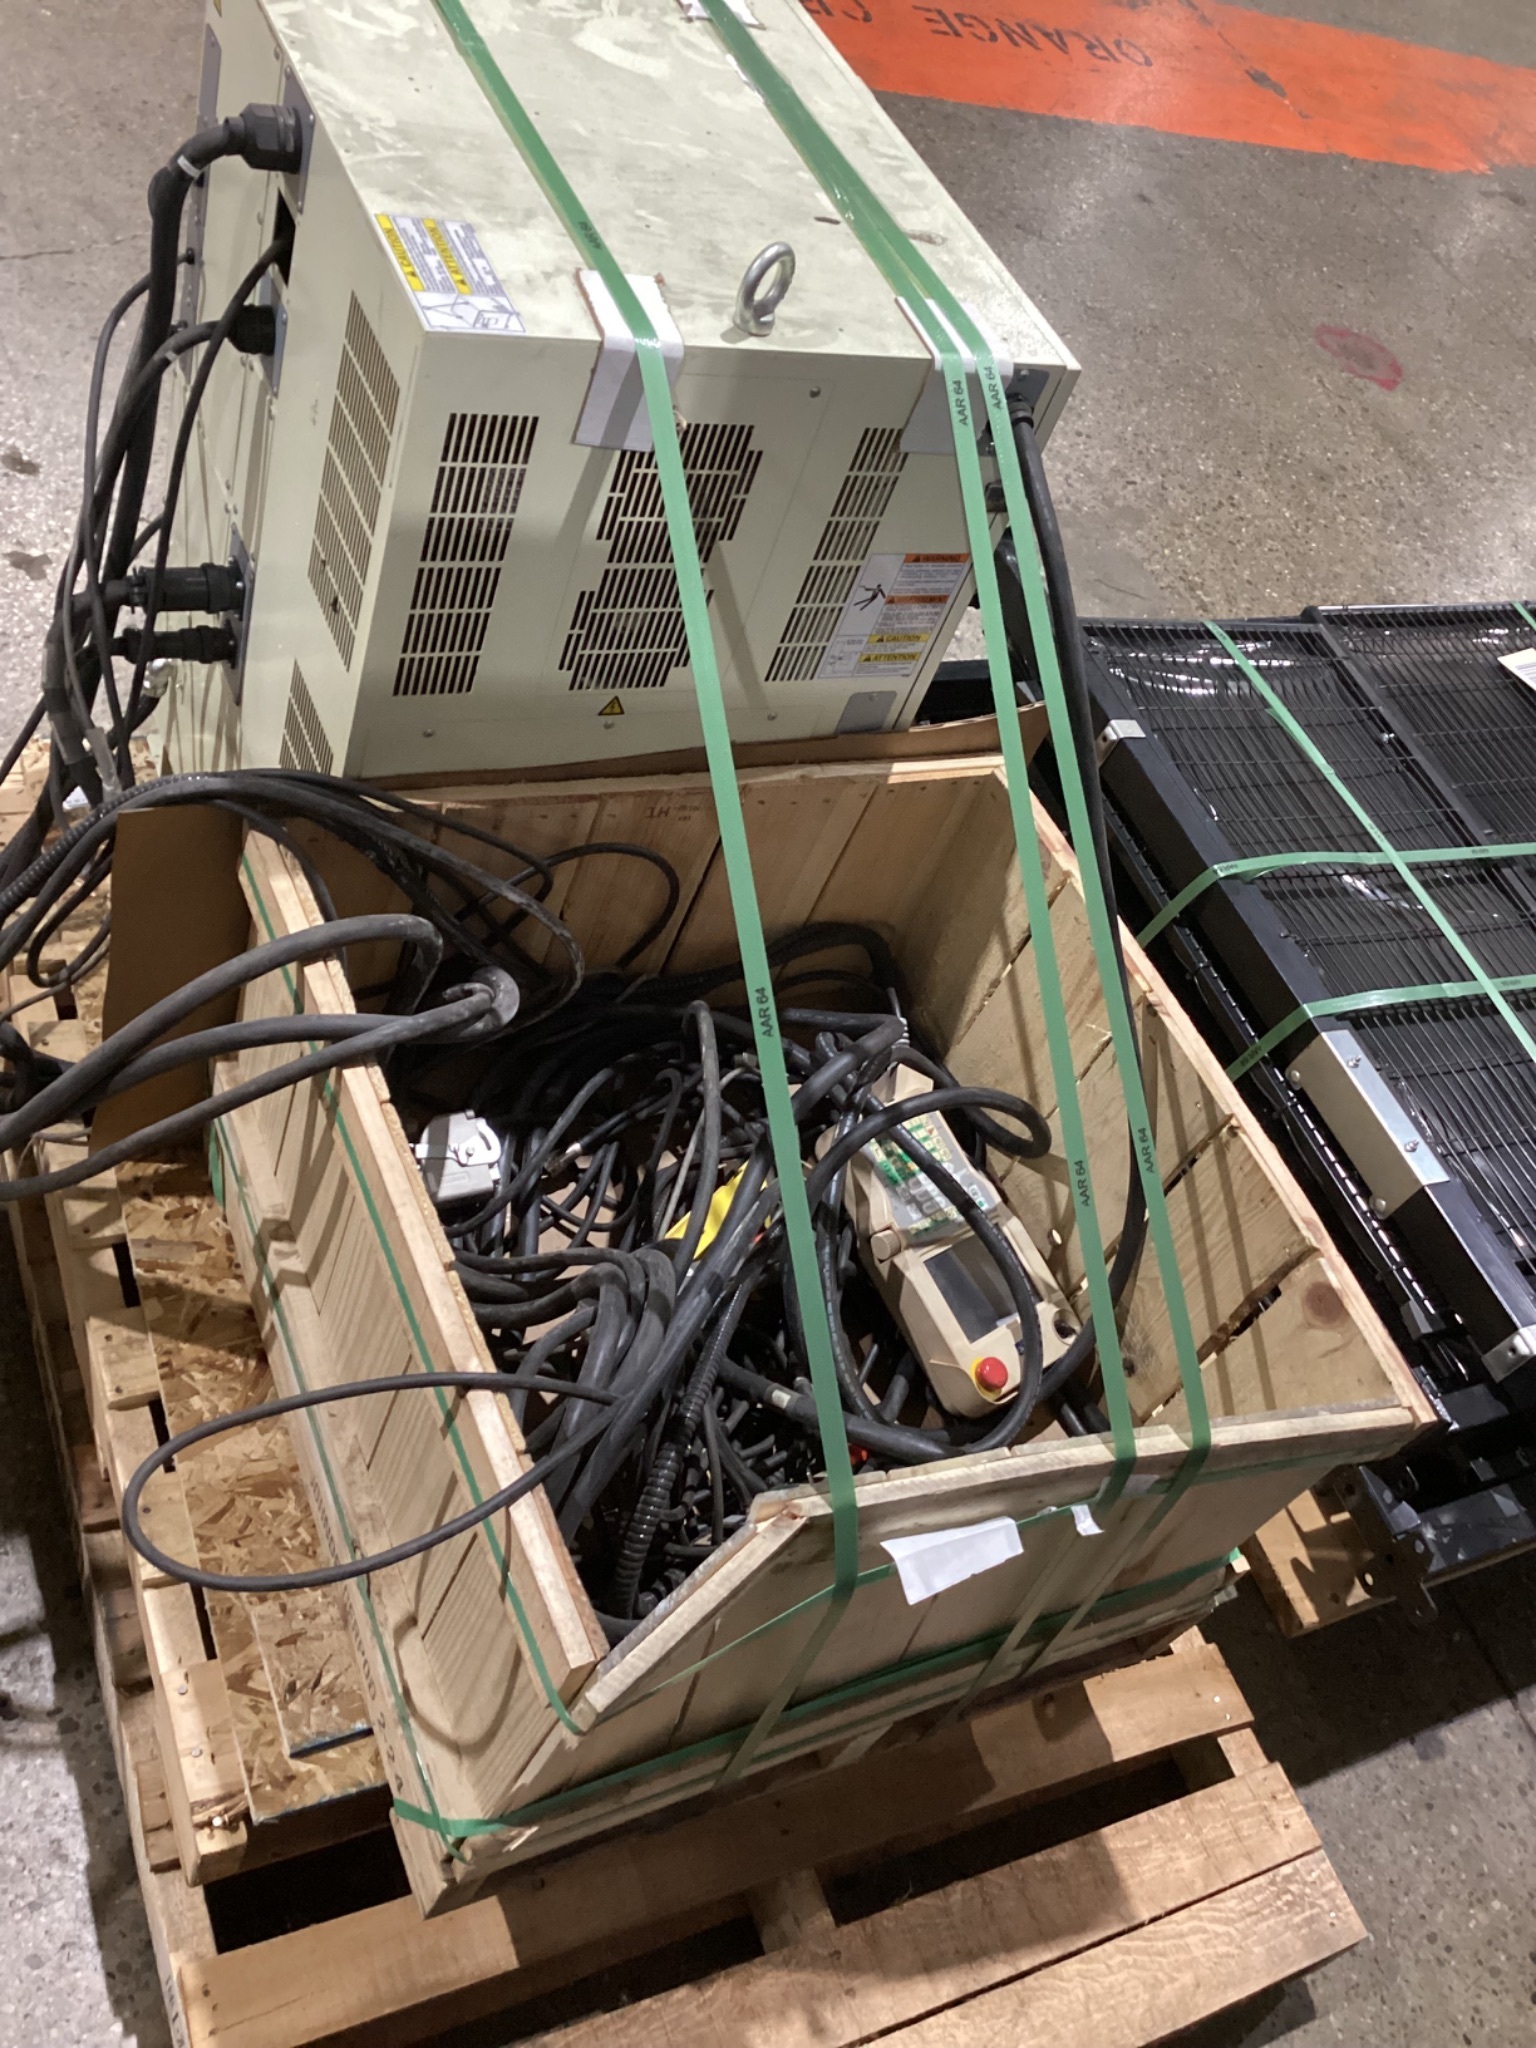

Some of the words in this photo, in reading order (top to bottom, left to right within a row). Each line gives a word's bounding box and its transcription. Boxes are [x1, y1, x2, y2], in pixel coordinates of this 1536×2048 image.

[911, 4, 1153, 67] ORANGE
[983, 365, 996, 380] 64
[952, 379, 964, 395] 64
[988, 382, 1004, 410] AAR
[955, 398, 969, 427] AAR
[885, 634, 921, 642] CAUTION
[872, 653, 917, 662] ATTENTION
[754, 986, 769, 1005] 64
[758, 1006, 774, 1038] AAR
[1137, 1127, 1149, 1143] 64
[1074, 1160, 1086, 1176] 64
[1141, 1145, 1155, 1174] AAR
[1077, 1178, 1090, 1207] AAR
